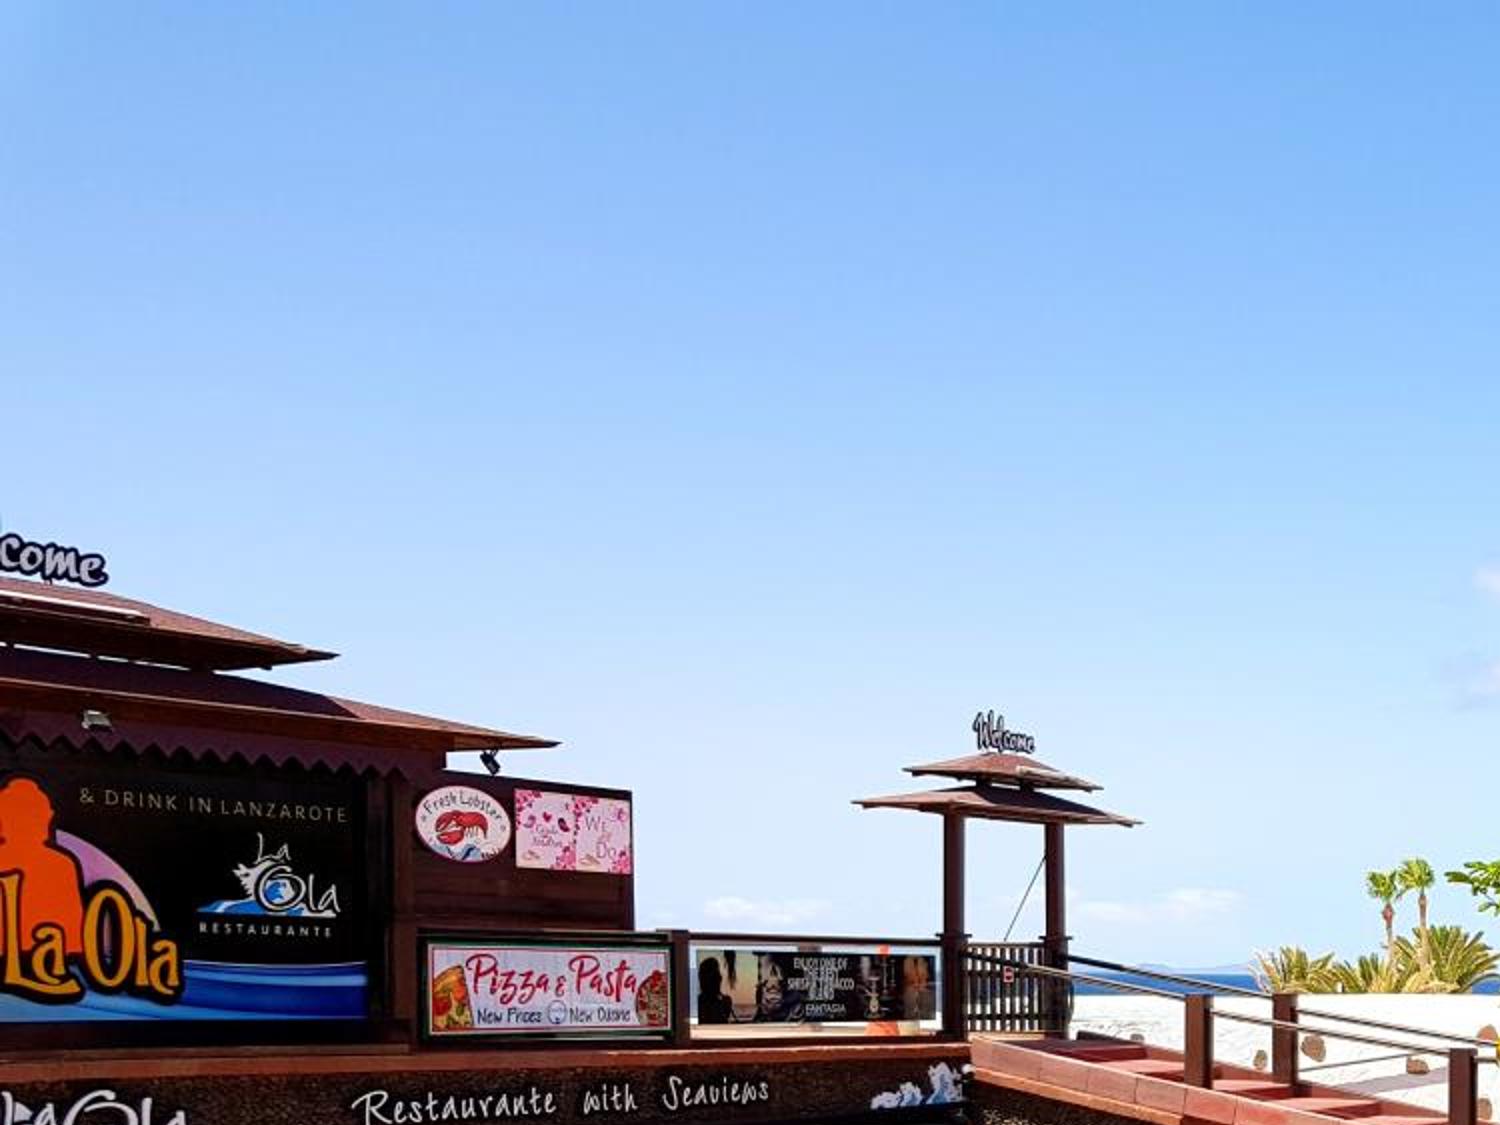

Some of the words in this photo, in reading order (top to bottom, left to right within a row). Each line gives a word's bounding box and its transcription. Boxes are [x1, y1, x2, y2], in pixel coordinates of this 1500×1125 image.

[973, 710, 1035, 753] Welcome
[104, 788, 178, 811] DRINK
[188, 797, 212, 814] IN
[220, 801, 348, 823] LANZAROTE
[423, 791, 457, 815] Fresh
[459, 790, 503, 821] Lobster
[253, 831, 292, 865] La
[257, 864, 341, 914] Ola
[2, 871, 83, 996] La
[83, 887, 180, 996] Ola
[199, 921, 333, 939] RESTAURANTE
[465, 953, 550, 1005] Pizza
[568, 954, 637, 1003] Pasta
[476, 1007, 502, 1025] New
[569, 1007, 593, 1022] New
[584, 1083, 638, 1116] with
[661, 1075, 769, 1110] Seaviews
